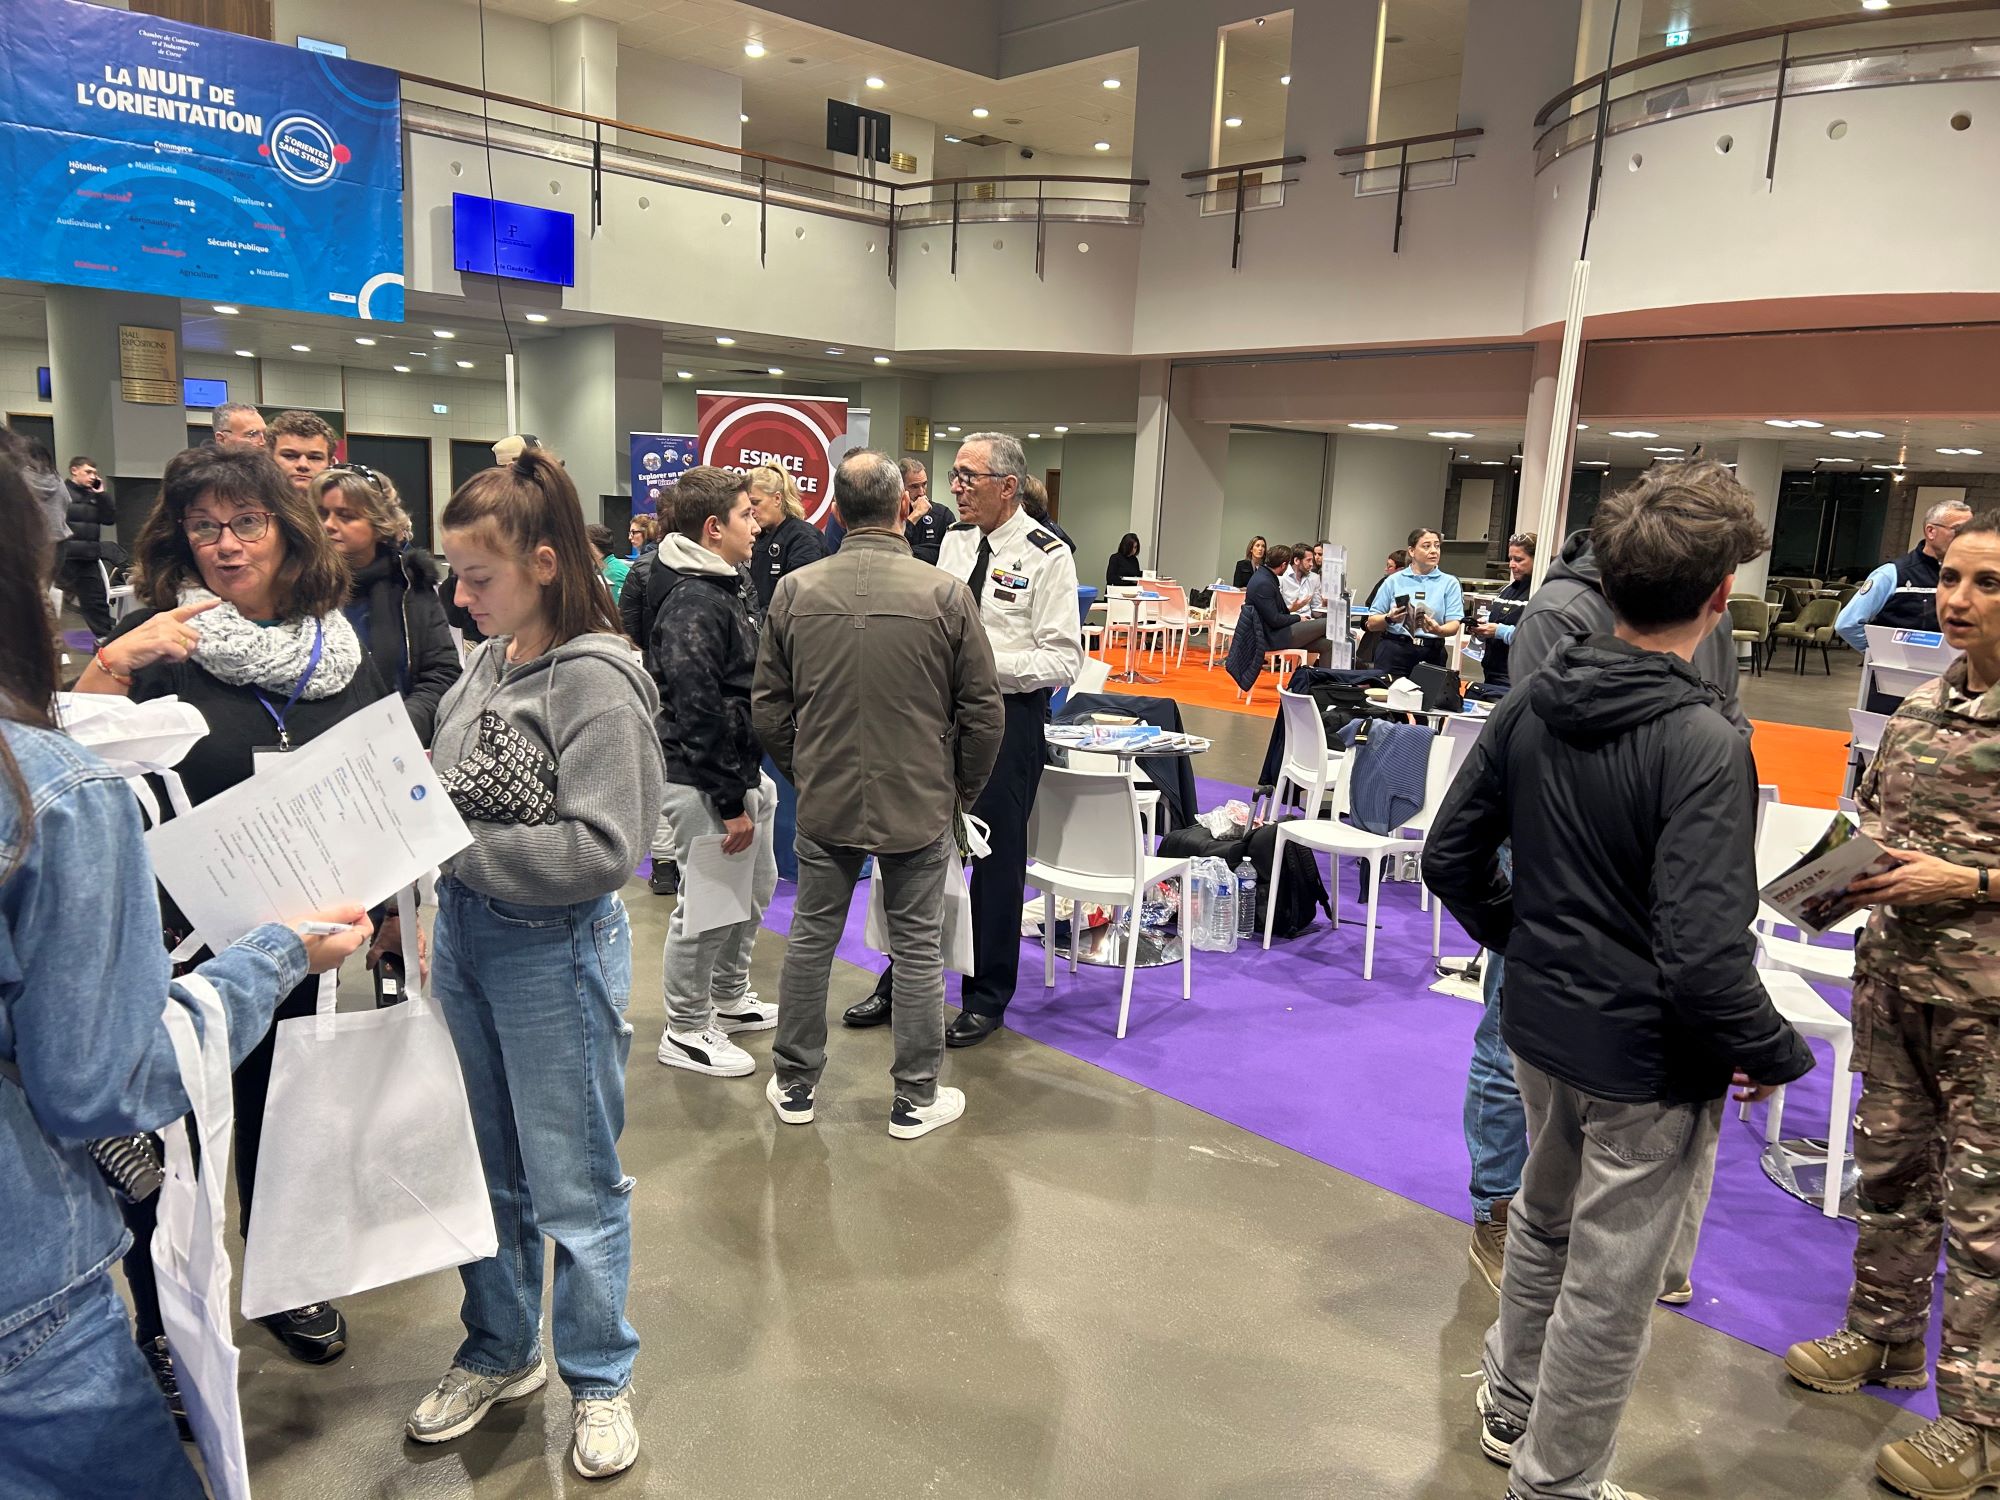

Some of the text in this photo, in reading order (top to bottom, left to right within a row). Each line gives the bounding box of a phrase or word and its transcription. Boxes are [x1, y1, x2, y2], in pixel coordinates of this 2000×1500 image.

[105, 65, 235, 106] LA NUIT DE
[77, 83, 262, 136] L'ORIENTATION
[154, 140, 193, 153] Commerce
[278, 142, 330, 170] SANS STRESS
[284, 134, 328, 161] S'ORIENTER
[68, 160, 108, 174] Hôtellerie
[135, 161, 177, 174] Multimédia
[174, 197, 196, 207] Santé
[233, 196, 265, 207] Tourisme
[56, 217, 102, 230] Audiovisuel
[207, 238, 269, 254] Sécurité Publique
[256, 268, 289, 279] Nautisme
[122, 330, 139, 339] HALL
[122, 339, 166, 350] EXPOSITIONS
[740, 448, 804, 472] ESPACE
[638, 472, 667, 481] Explorer
[494, 734, 534, 768] MARC
[508, 728, 544, 762] MARC
[498, 750, 544, 794] JACOBS
[460, 780, 502, 814] MARC
[477, 774, 520, 811] MARC
[520, 808, 540, 824] BY
[509, 780, 546, 814] MARC
